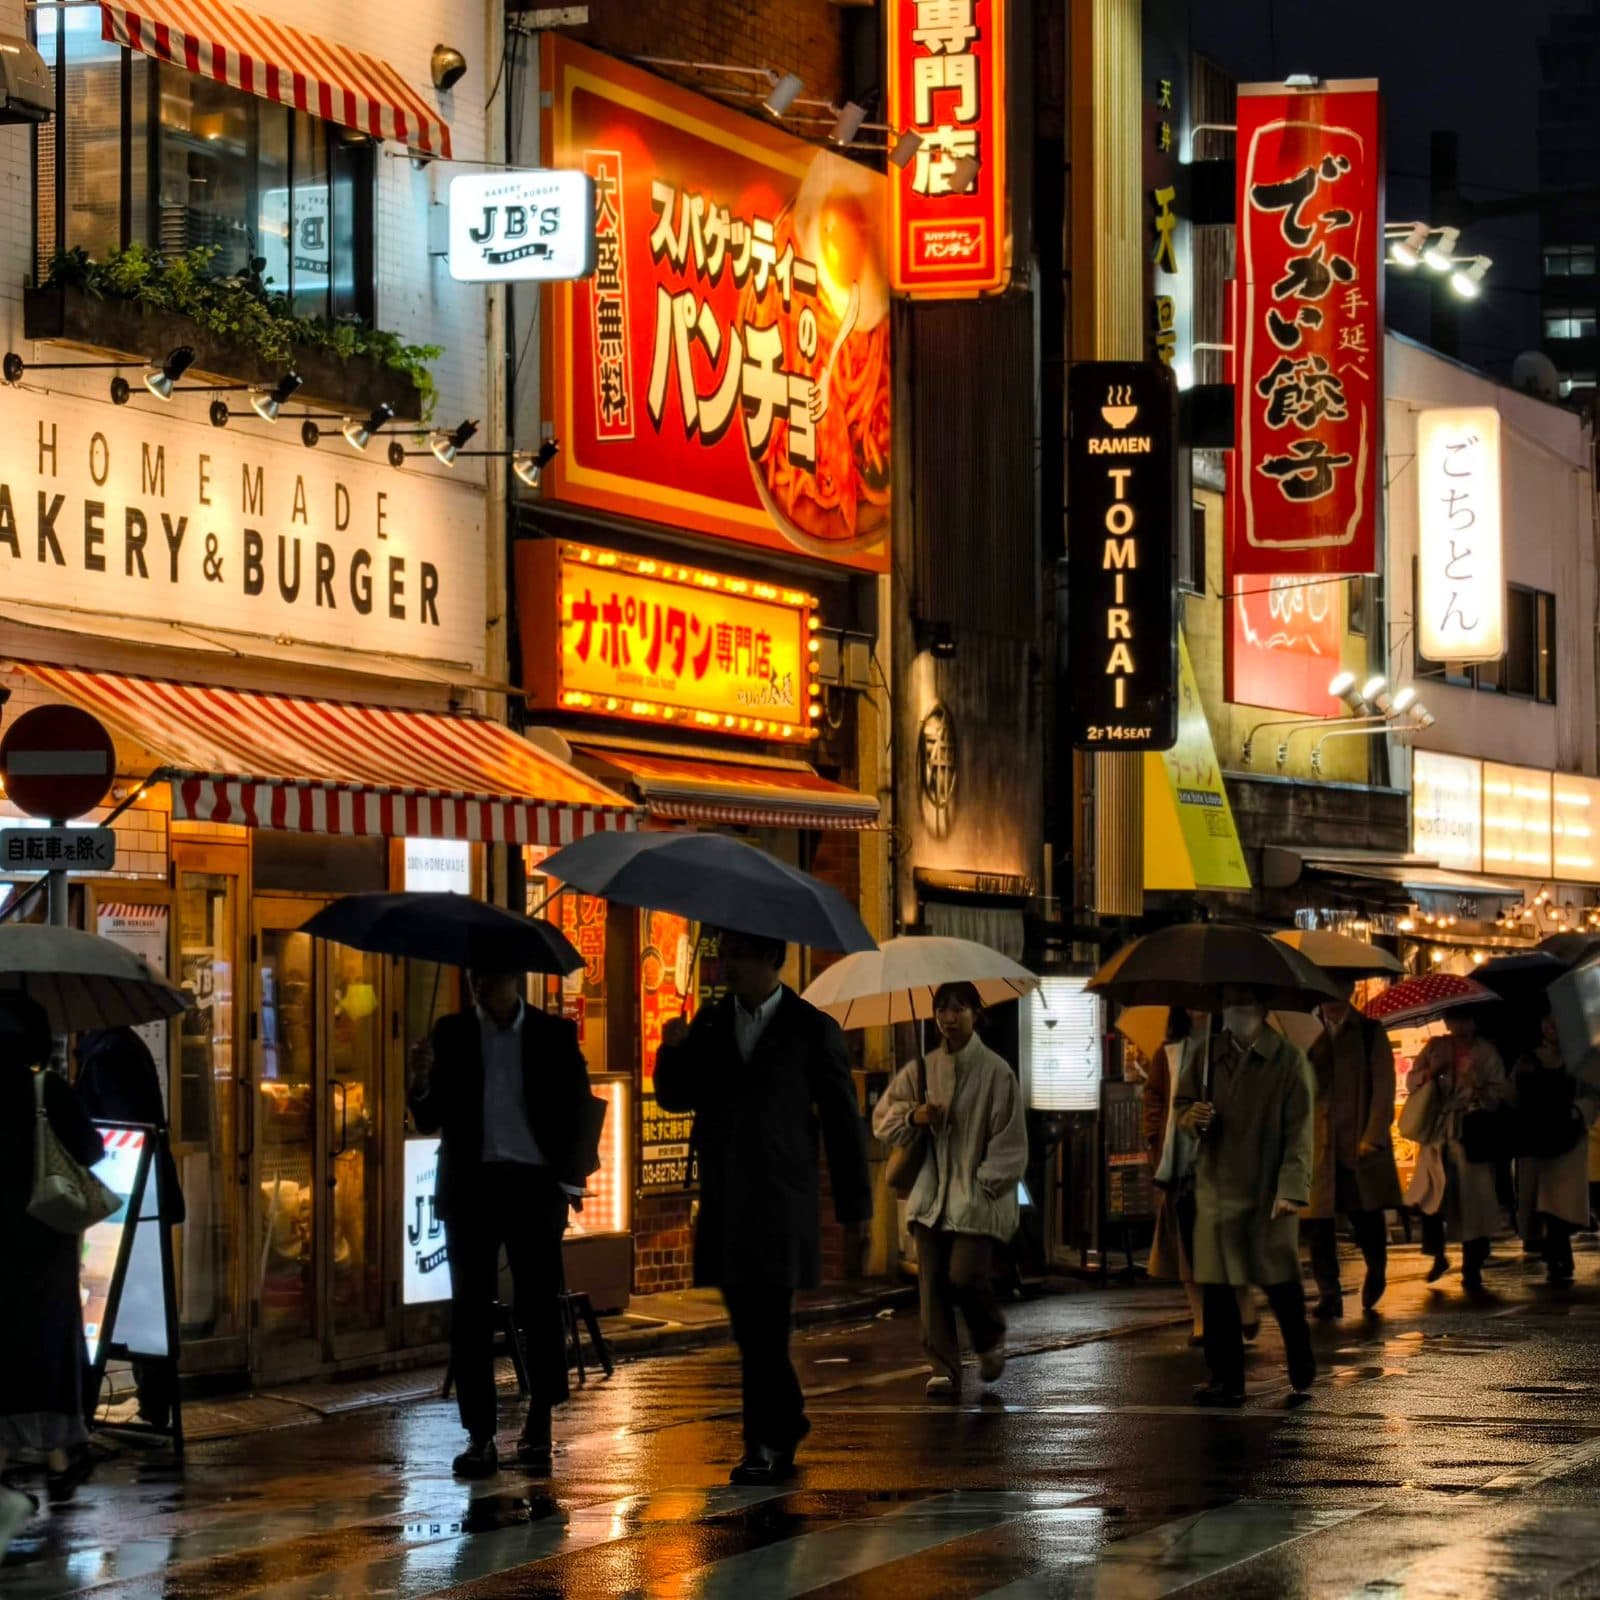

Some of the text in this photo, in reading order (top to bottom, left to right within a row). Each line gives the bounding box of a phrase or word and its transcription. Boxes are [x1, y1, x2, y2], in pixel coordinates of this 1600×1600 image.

[469, 203, 561, 244] JB'S
[498, 245, 535, 262] TOKYO
[595, 163, 627, 427] 大盛無料
[1249, 152, 1356, 502] でっかい餃子
[648, 284, 817, 475] パンチョ
[38, 420, 388, 540] HOMEMADE
[1088, 437, 1150, 454] RAMEN
[244, 528, 440, 626] BURGER
[1103, 468, 1137, 709] TOMIRAI
[1440, 435, 1479, 632] ごちとん
[9, 836, 105, 861] 自転車を除く
